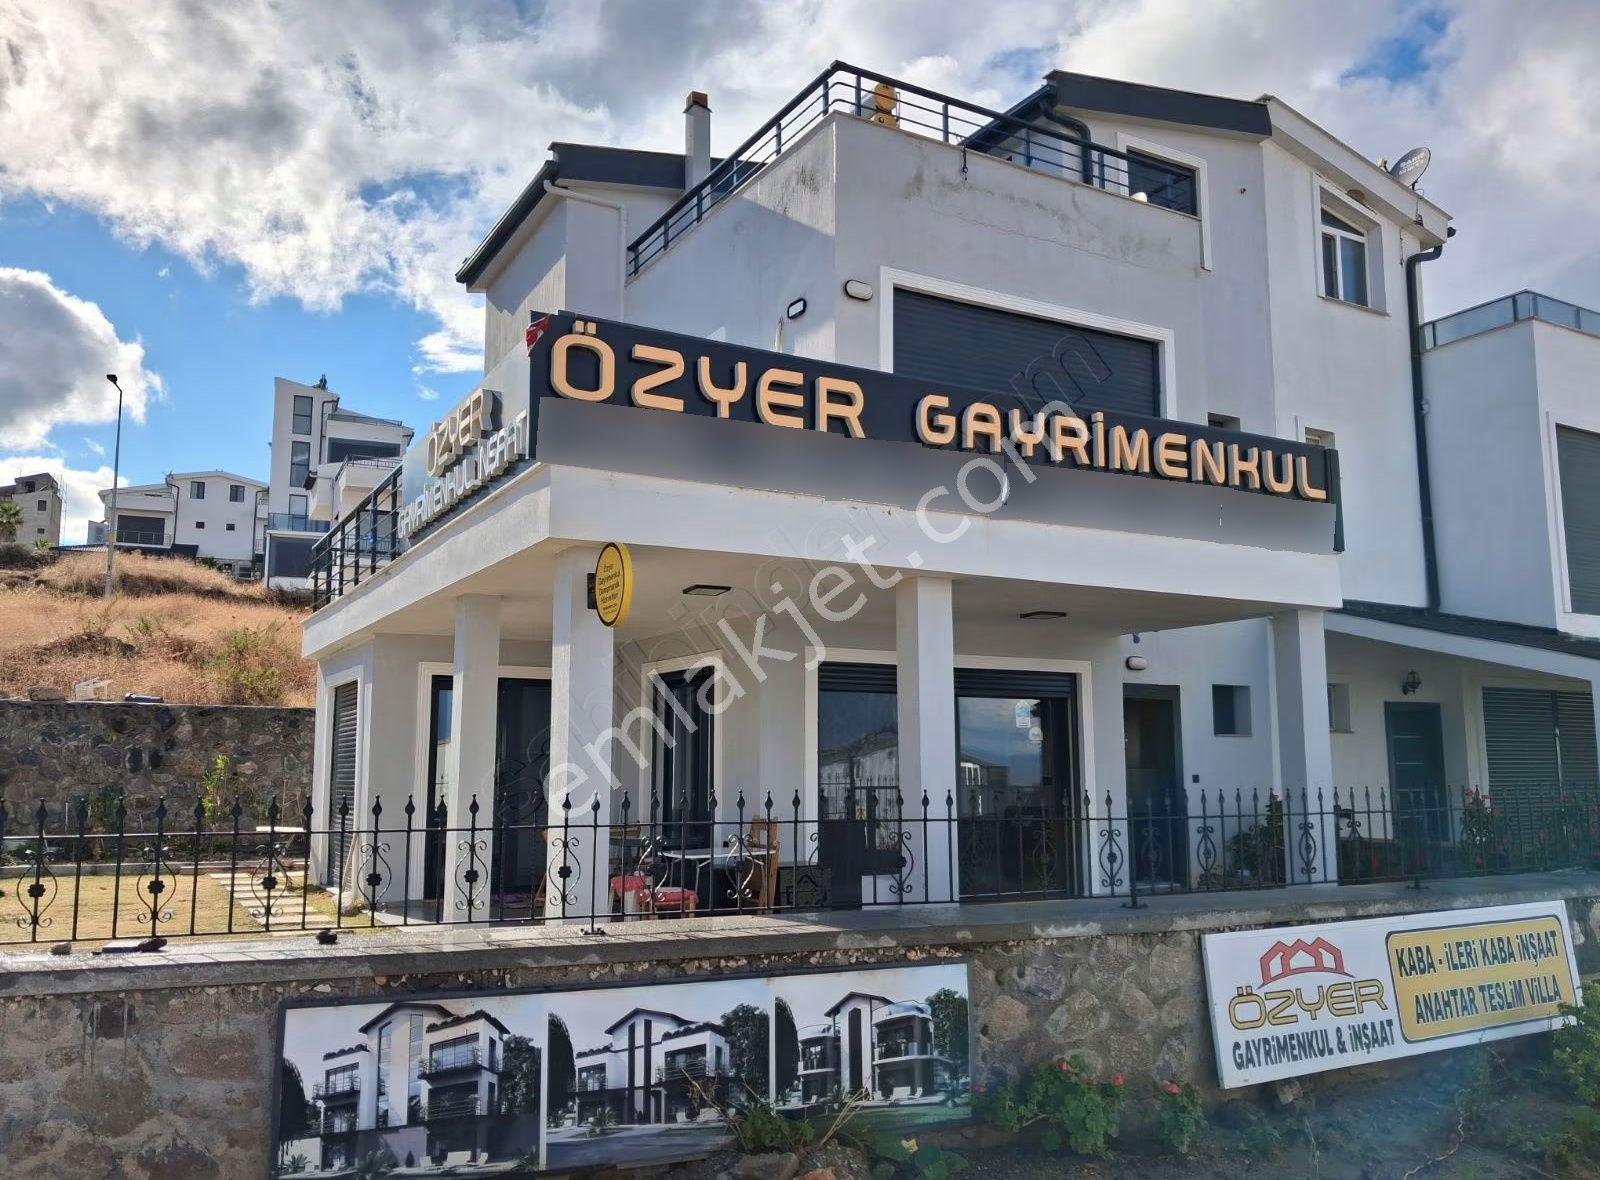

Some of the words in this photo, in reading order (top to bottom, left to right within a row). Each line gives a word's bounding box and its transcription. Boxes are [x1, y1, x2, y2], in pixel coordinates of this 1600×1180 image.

[427, 389, 492, 478] ÖZYER
[551, 320, 866, 439] ÖZYER
[915, 394, 1327, 501] GAYRİMENKUL
[1395, 943, 1436, 978] KABA
[1444, 938, 1477, 972] İLERİ
[1478, 934, 1516, 964] KABA
[1516, 929, 1560, 968] İNŞAAT
[1228, 978, 1389, 1031] ÖZYER
[1414, 986, 1478, 1025] ANAHTAR
[1478, 979, 1527, 1013] TESLİM
[1528, 974, 1563, 1009] VİLLA
[1232, 1026, 1335, 1072] GAYRİMENKUL
[1336, 1029, 1349, 1055] &
[1349, 1018, 1396, 1055] İNŞAAT
